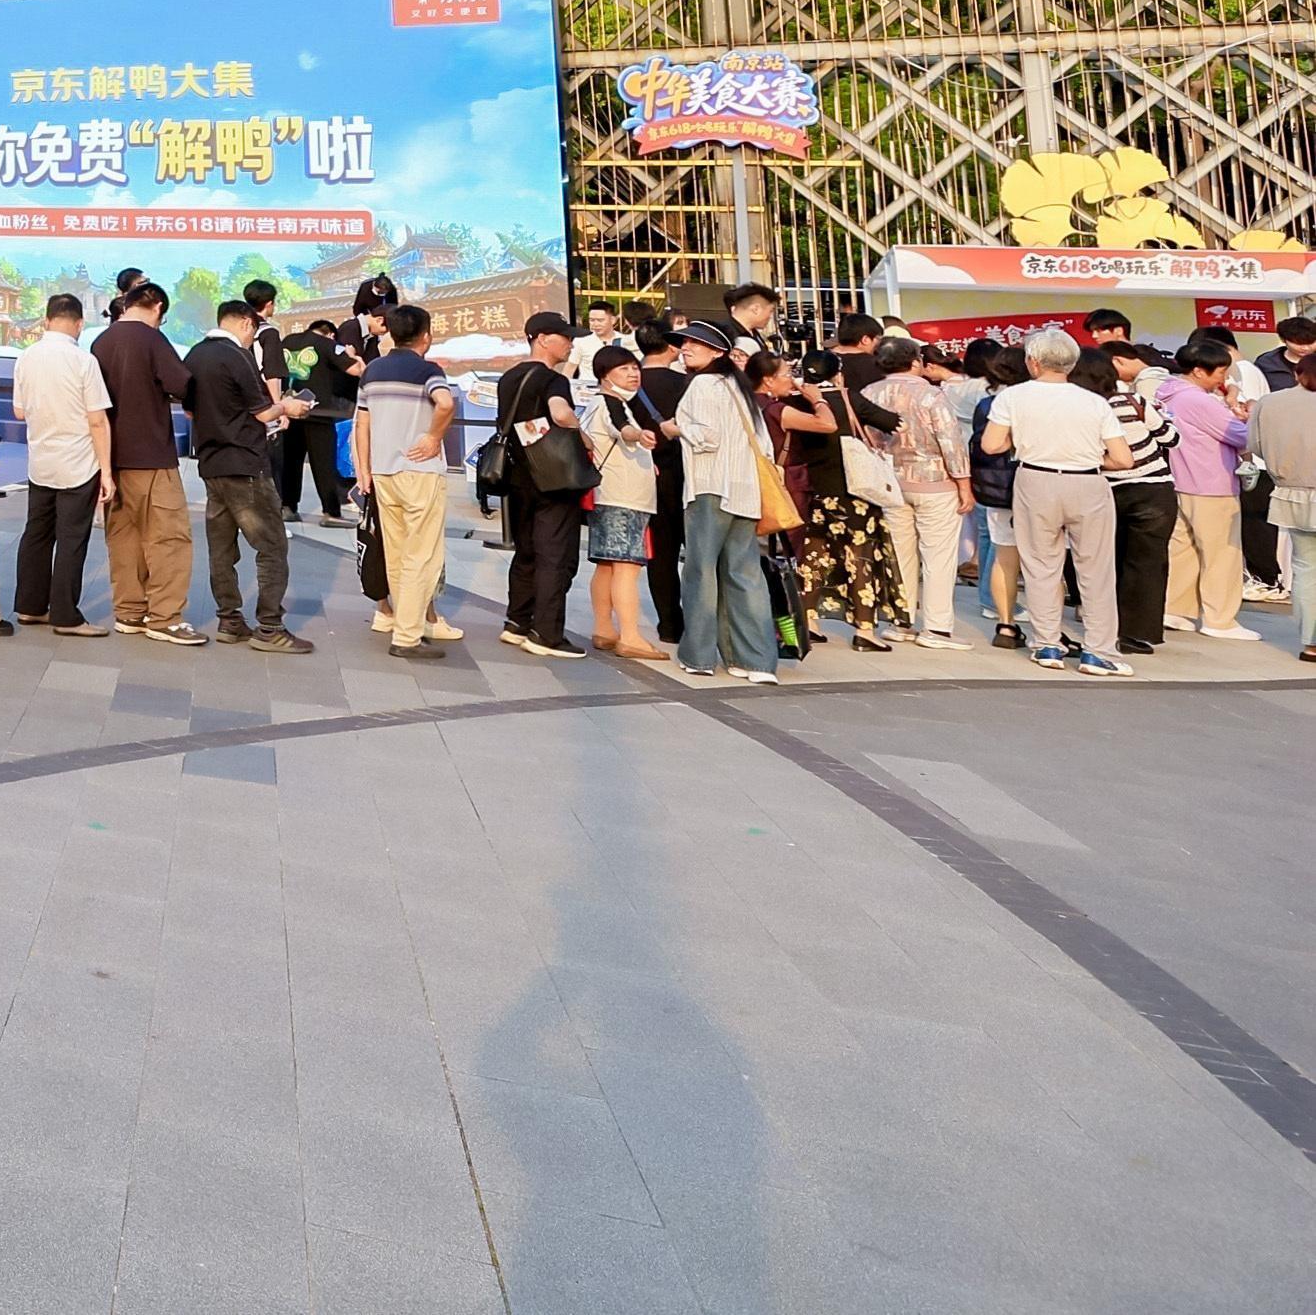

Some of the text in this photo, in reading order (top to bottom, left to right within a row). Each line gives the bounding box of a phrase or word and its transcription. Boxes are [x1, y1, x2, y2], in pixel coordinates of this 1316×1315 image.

[10, 61, 255, 104] 京东解鸭大集
[723, 55, 785, 72] 南京站
[624, 58, 810, 121] 中华美食大赛
